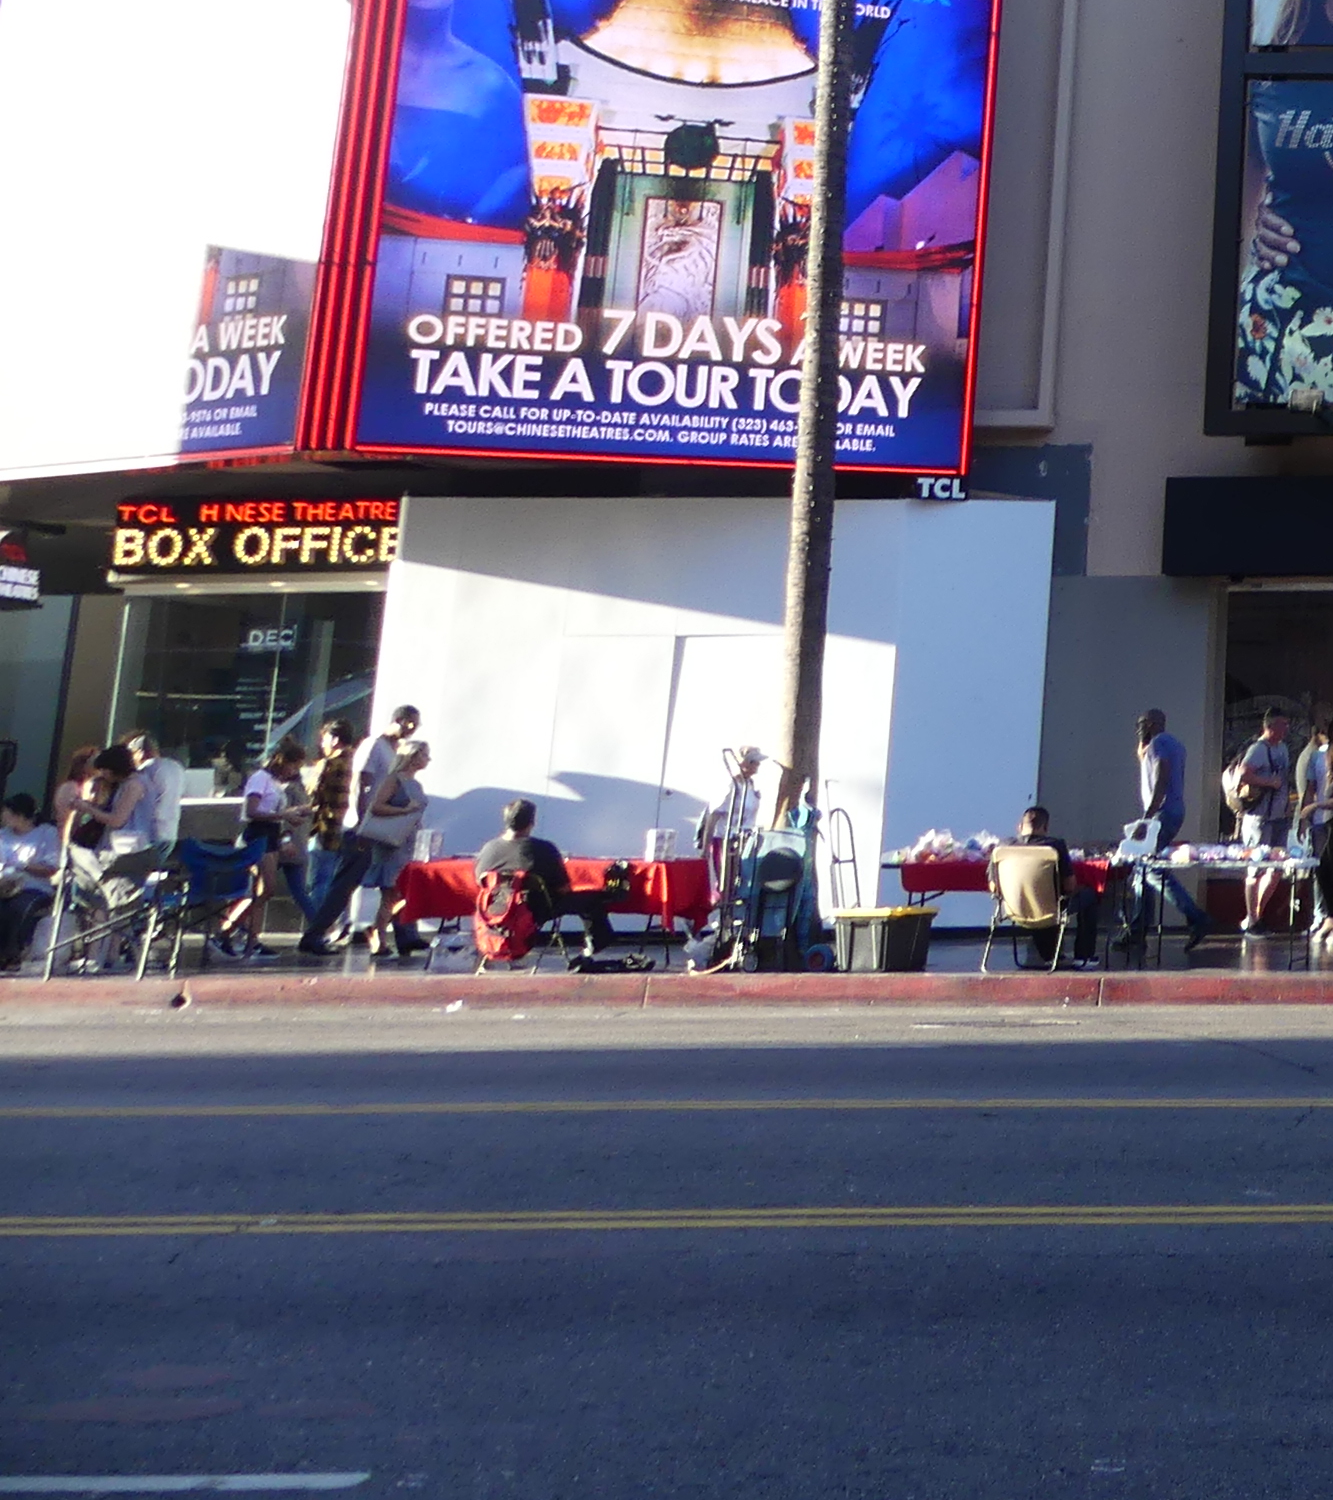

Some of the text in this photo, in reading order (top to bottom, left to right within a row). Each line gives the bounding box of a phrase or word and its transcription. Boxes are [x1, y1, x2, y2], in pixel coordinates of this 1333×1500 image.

[855, 2, 892, 20] ORLD
[190, 314, 288, 353] A WEEK
[407, 313, 584, 353] OFFERED
[602, 309, 637, 355] 7
[641, 311, 782, 366] DAYS
[838, 340, 927, 373] WEEK
[183, 350, 282, 405] ODAY
[410, 348, 544, 400] TAKE
[549, 357, 595, 402] A
[605, 359, 739, 410] TOUR
[424, 402, 476, 419] PLEASE
[479, 404, 516, 420] CALL
[519, 406, 549, 422] FOR
[552, 407, 636, 425] UP-TO-DATE
[640, 411, 730, 431] AVAILABILITY
[731, 415, 768, 435] (323)
[856, 423, 896, 438] EMAIL
[446, 419, 674, 443] TOURS@CHINESETHEATRES.COM.
[677, 431, 728, 446] GROUP
[731, 433, 770, 448] RATES
[773, 435, 799, 449] ARE
[916, 477, 966, 500] TCL
[117, 501, 398, 524] TCL HNESE THEATRE
[113, 525, 400, 566] BOX OFFICE
[248, 628, 295, 647] DEC
